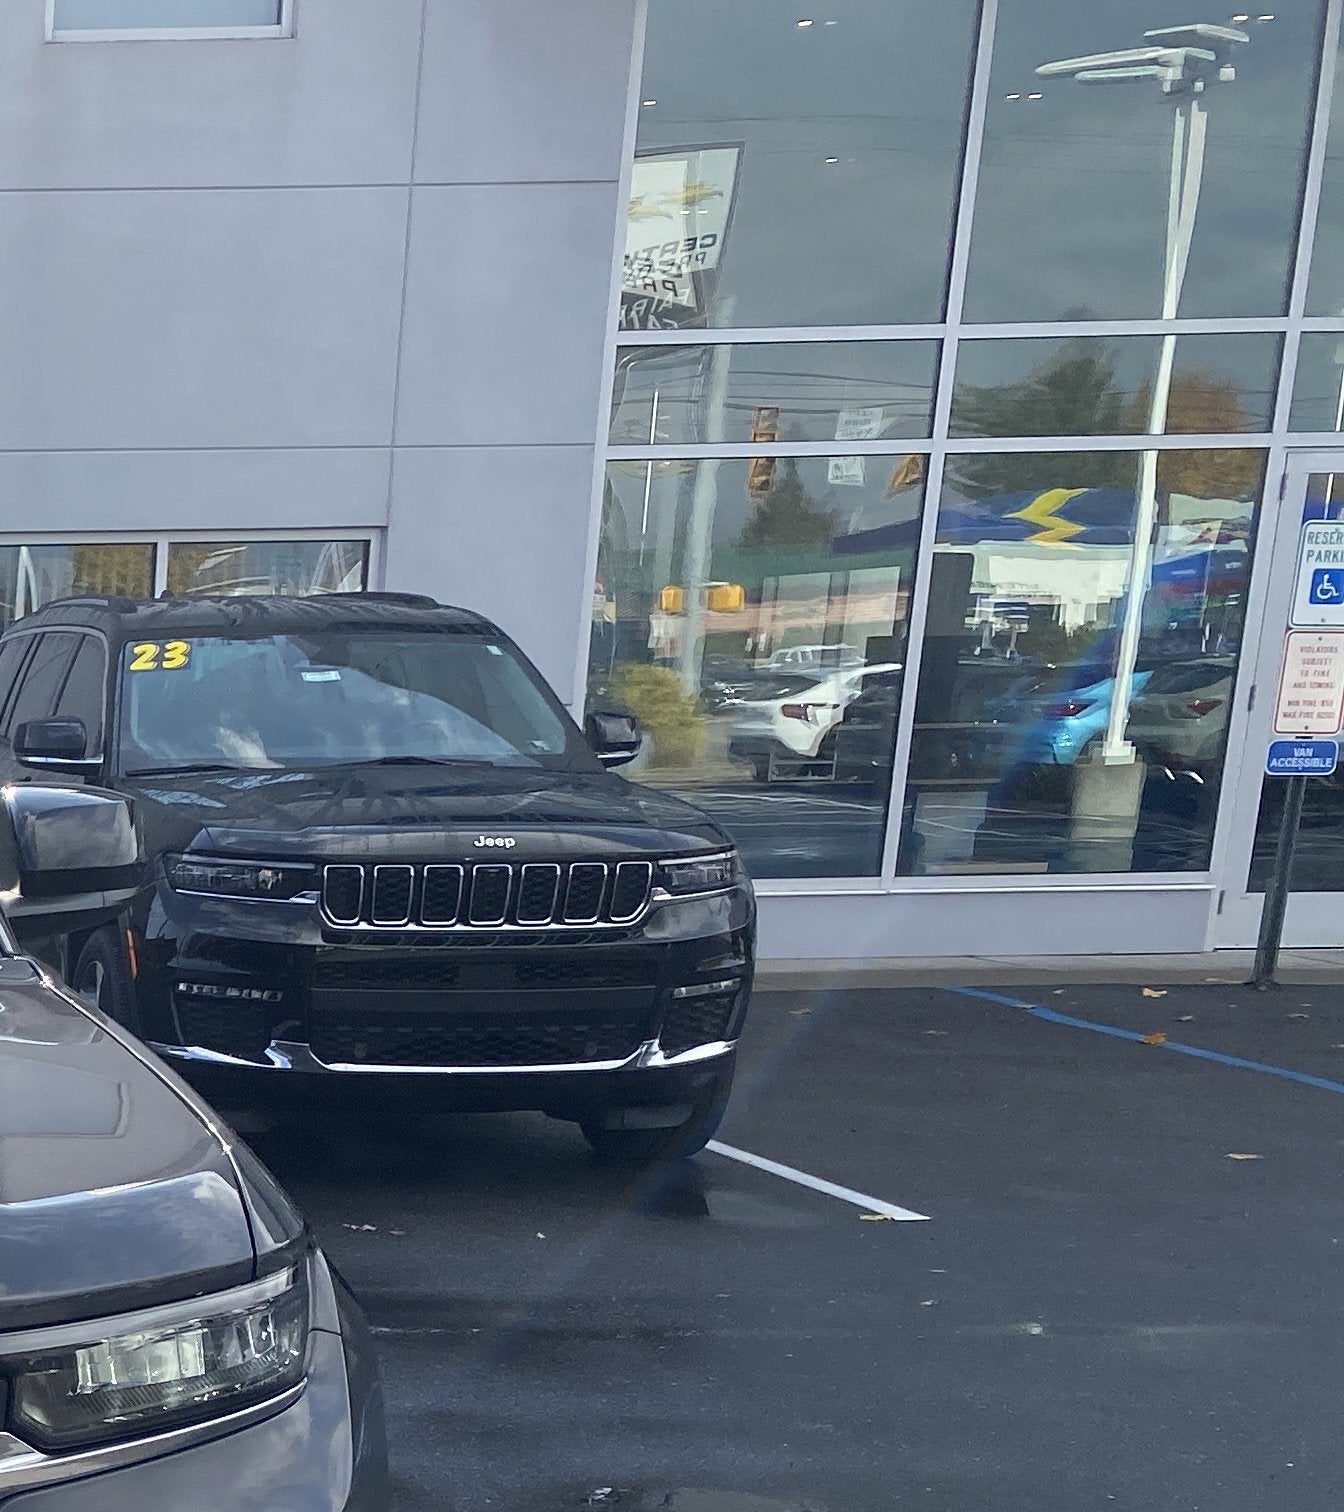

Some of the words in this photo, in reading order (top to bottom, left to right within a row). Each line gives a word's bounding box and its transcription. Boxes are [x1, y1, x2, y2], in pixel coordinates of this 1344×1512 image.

[129, 640, 190, 671] 23
[1293, 747, 1314, 758] VAN
[1269, 757, 1333, 768] ACCESSIBLE
[473, 835, 516, 849] Jeep
